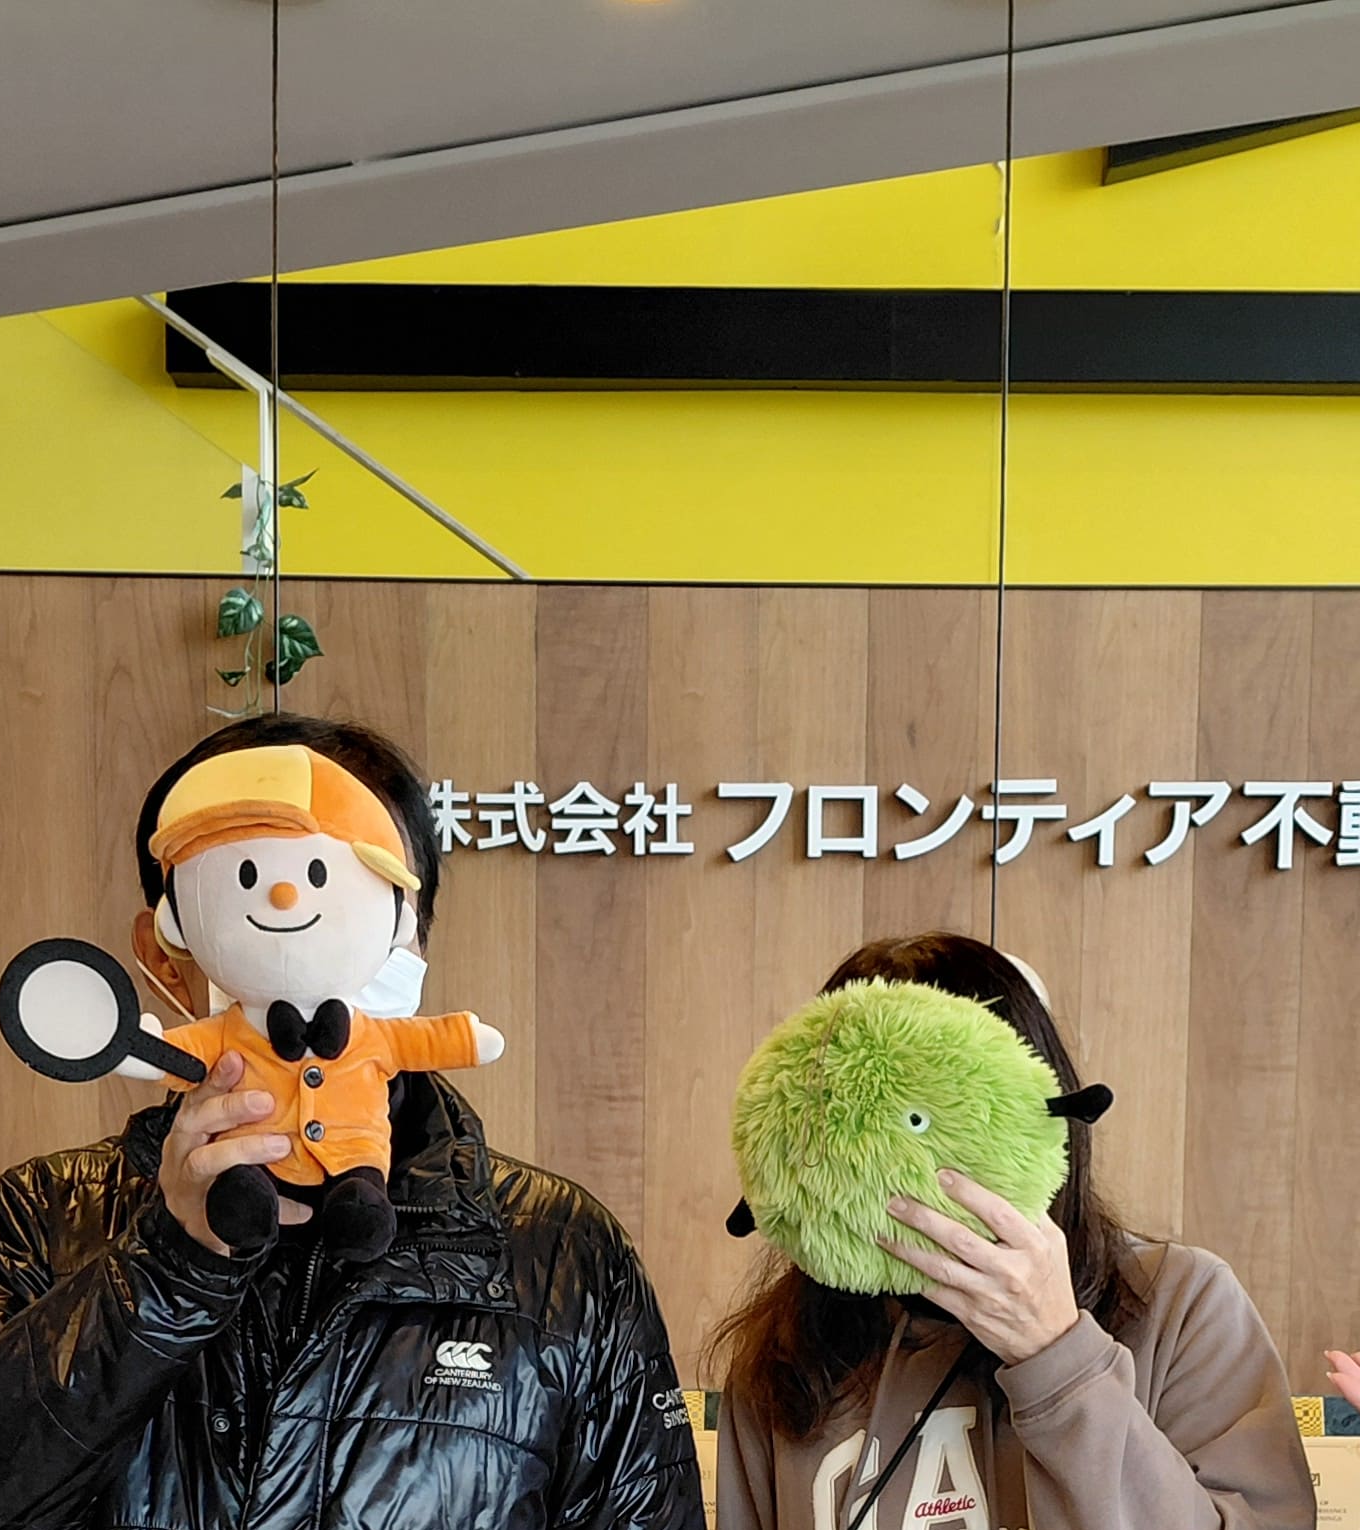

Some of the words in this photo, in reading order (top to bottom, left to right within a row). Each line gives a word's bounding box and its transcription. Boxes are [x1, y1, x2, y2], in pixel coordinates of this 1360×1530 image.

[429, 780, 695, 856] 株式会社
[424, 1376, 438, 1385] OF
[439, 1378, 460, 1387] NEW
[461, 1379, 502, 1392] ZEALAND
[434, 1368, 493, 1380] CANTERBURY
[914, 1495, 977, 1519] Athletic
